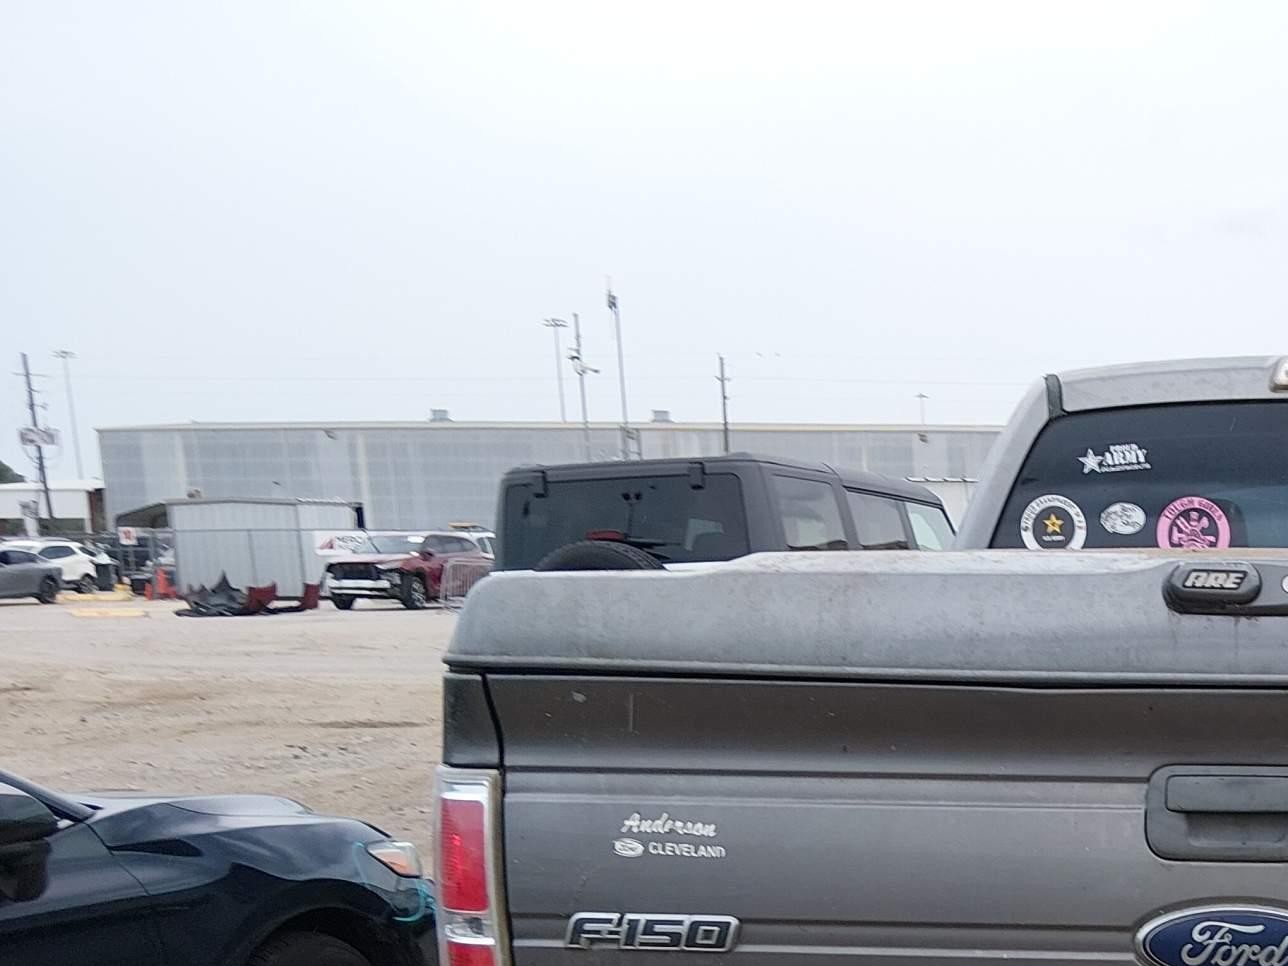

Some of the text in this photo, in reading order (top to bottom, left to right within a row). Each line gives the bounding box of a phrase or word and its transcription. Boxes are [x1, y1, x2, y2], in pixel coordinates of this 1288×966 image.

[1102, 448, 1147, 465] ARMY
[620, 812, 717, 837] Anderson
[648, 841, 727, 858] CLEVELAND
